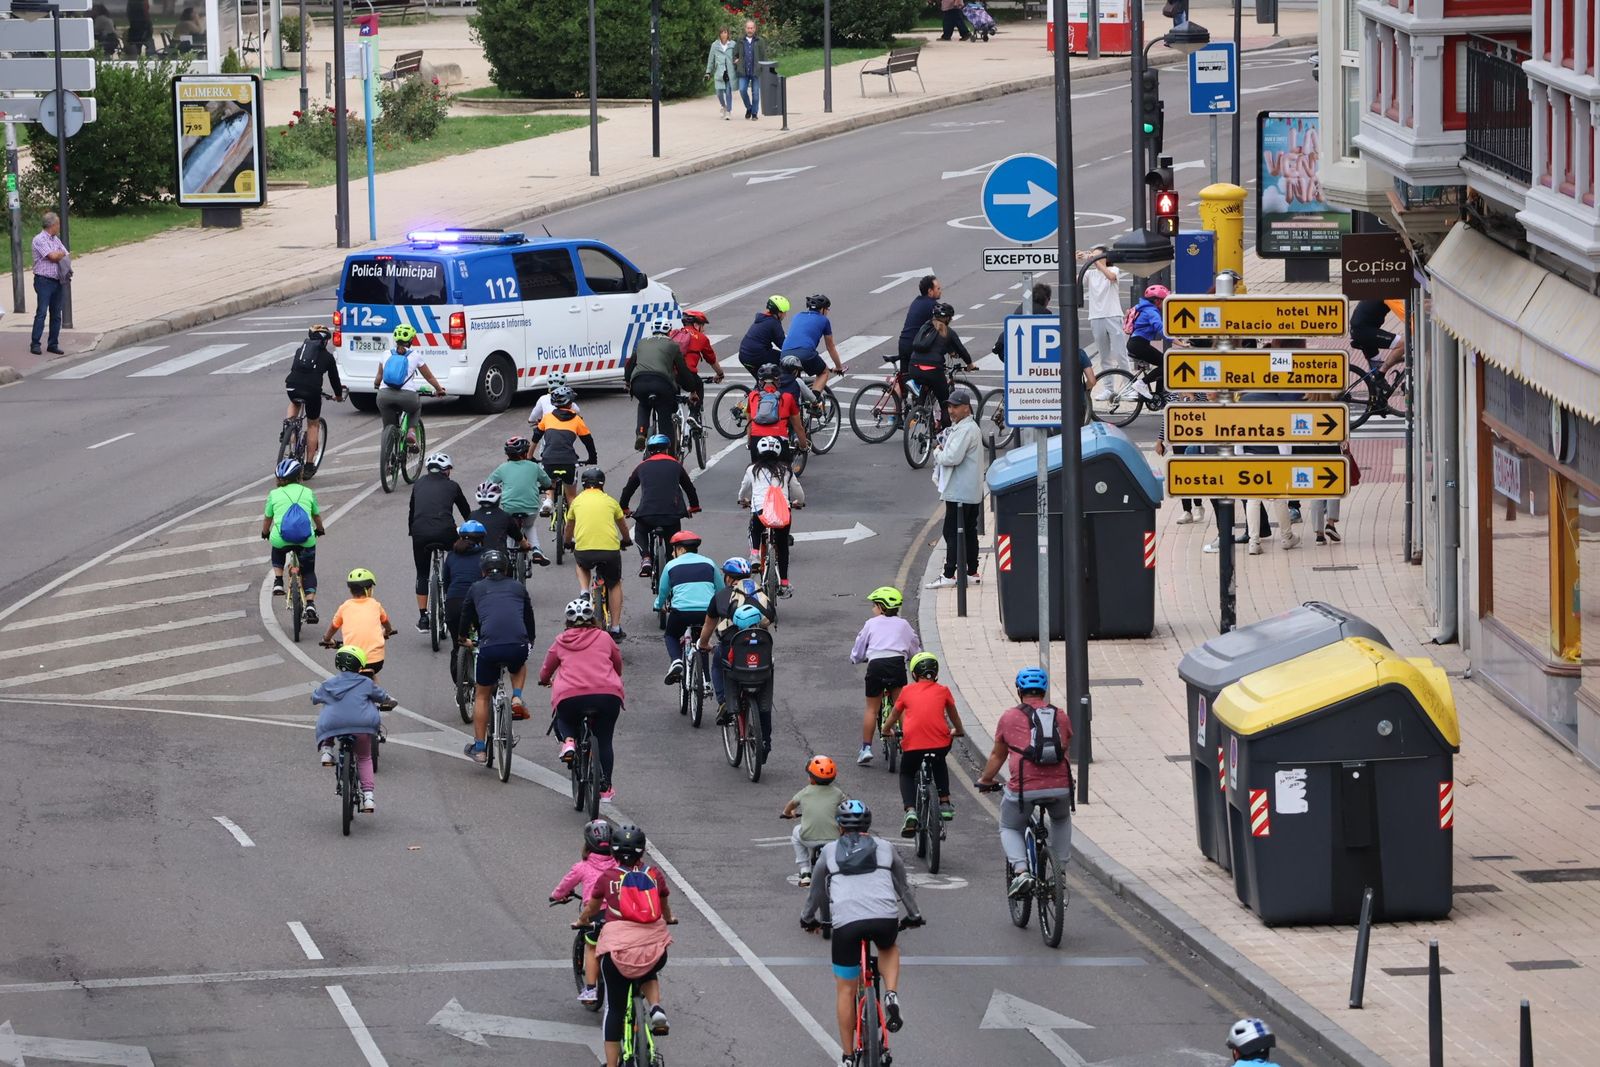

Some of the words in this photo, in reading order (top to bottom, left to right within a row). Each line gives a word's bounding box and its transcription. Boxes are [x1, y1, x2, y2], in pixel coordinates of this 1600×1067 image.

[183, 87, 232, 97] ALIMERKA
[1264, 150, 1316, 178] VEN
[985, 254, 1042, 264] EXCEPTO
[1043, 254, 1059, 264] BU
[352, 263, 383, 277] Policía
[386, 264, 437, 280] Municipal
[485, 277, 518, 300] 112
[340, 306, 373, 326] 112
[1277, 306, 1309, 316] hotel
[1317, 305, 1338, 316] NH
[471, 320, 500, 331] Atestados
[507, 318, 532, 328] Informes
[1225, 320, 1272, 330] Palacio
[1278, 321, 1295, 330] del
[1300, 320, 1338, 330] Duero
[537, 345, 567, 360] Policía
[569, 340, 612, 359] Municipal
[1038, 328, 1061, 359] P
[1028, 365, 1062, 376] PÚBLI
[1225, 371, 1255, 383] Real
[1263, 371, 1279, 383] de
[1287, 372, 1338, 384] Zamora
[1174, 412, 1206, 421] hotel
[1174, 424, 1203, 436] Dos
[1215, 424, 1285, 437] Infantas
[1175, 474, 1224, 485] hostal
[1238, 470, 1273, 485] Sol
